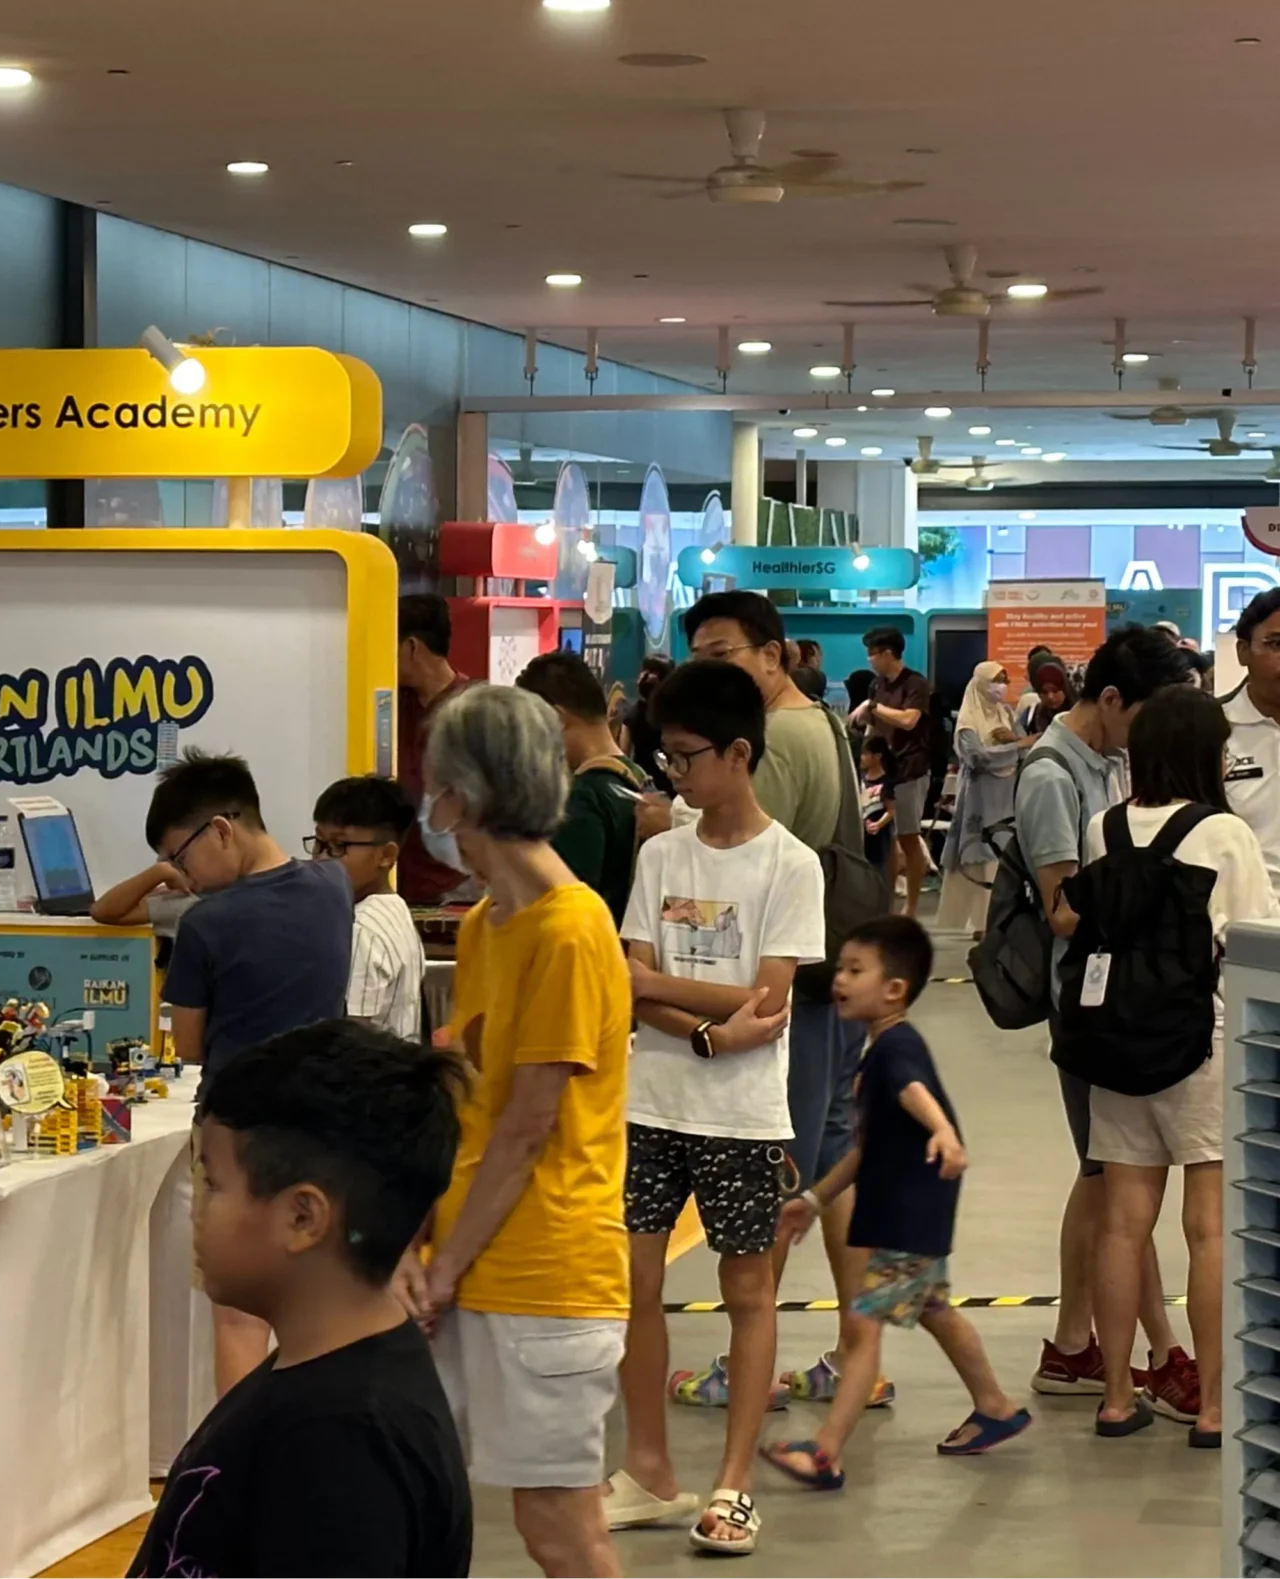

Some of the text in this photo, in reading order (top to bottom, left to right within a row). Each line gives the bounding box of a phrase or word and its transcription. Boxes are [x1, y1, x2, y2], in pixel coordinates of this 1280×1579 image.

[56, 394, 261, 437] Academy
[752, 560, 836, 574] HealthierSG
[61, 663, 206, 732] ILMU
[83, 979, 126, 989] RAIKAN
[83, 990, 126, 1005] ILMU
